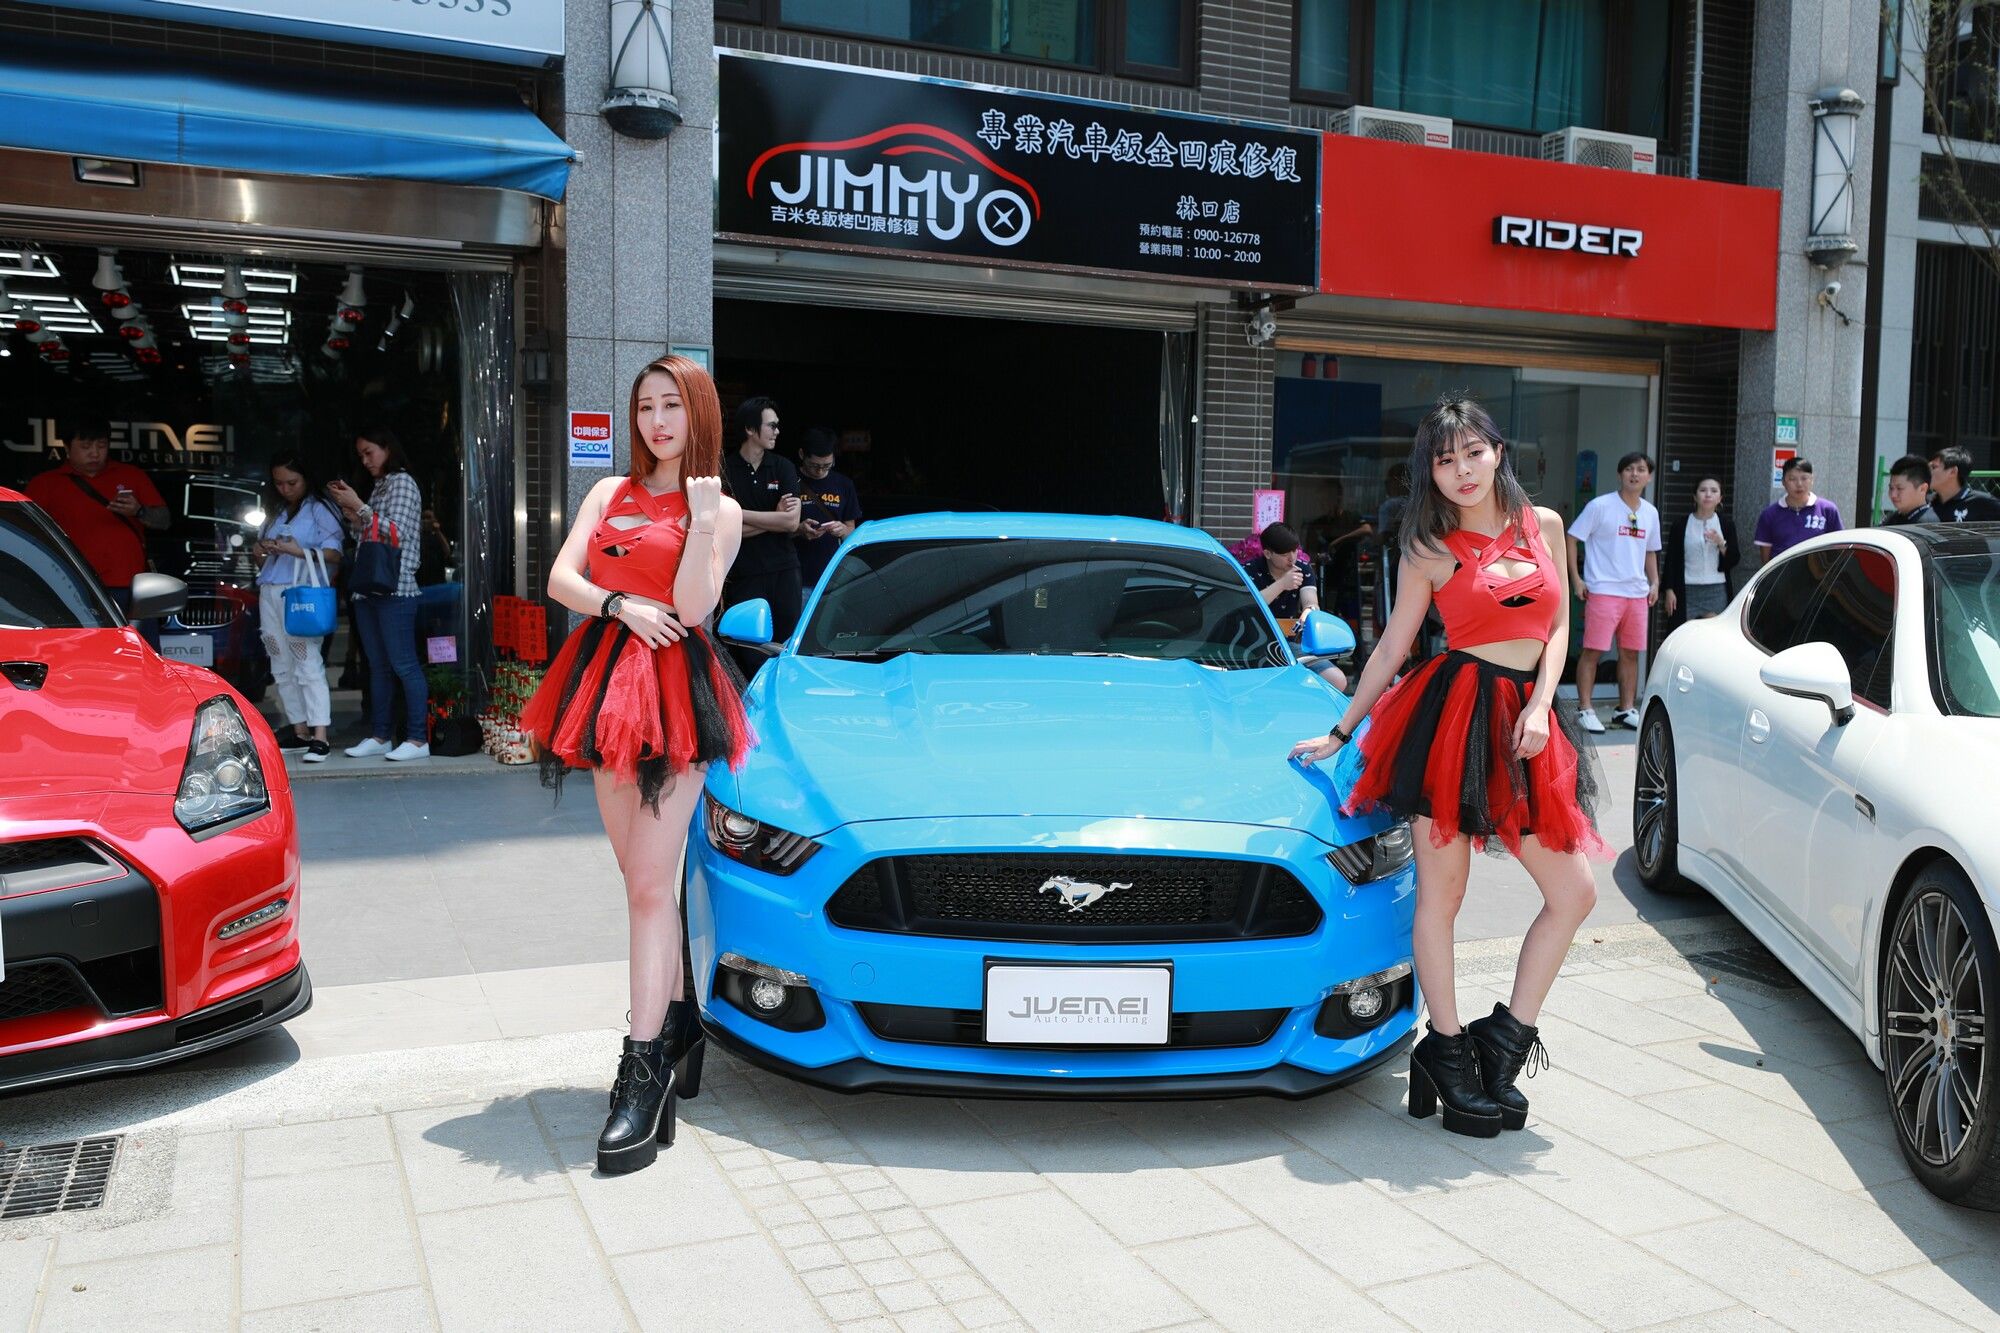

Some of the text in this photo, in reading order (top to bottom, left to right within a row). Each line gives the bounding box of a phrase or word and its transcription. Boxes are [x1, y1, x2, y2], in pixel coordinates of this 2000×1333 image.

[977, 109, 1301, 182] 專業汽車鈑金凹痕修復
[1176, 195, 1240, 224] 林口店
[770, 205, 919, 236] 吉米免鈑烤凹痕修復
[1193, 228, 1260, 246] 0900-126778
[1501, 215, 1644, 257] RIDER
[1194, 246, 1221, 260] 10:00
[1234, 250, 1261, 264] 20:00
[574, 442, 608, 452] SECOM
[121, 449, 236, 467] Detailing
[821, 493, 840, 503] 404
[1008, 996, 1148, 1019] JUEMEI
[1034, 1014, 1148, 1025] Auto Detailing
